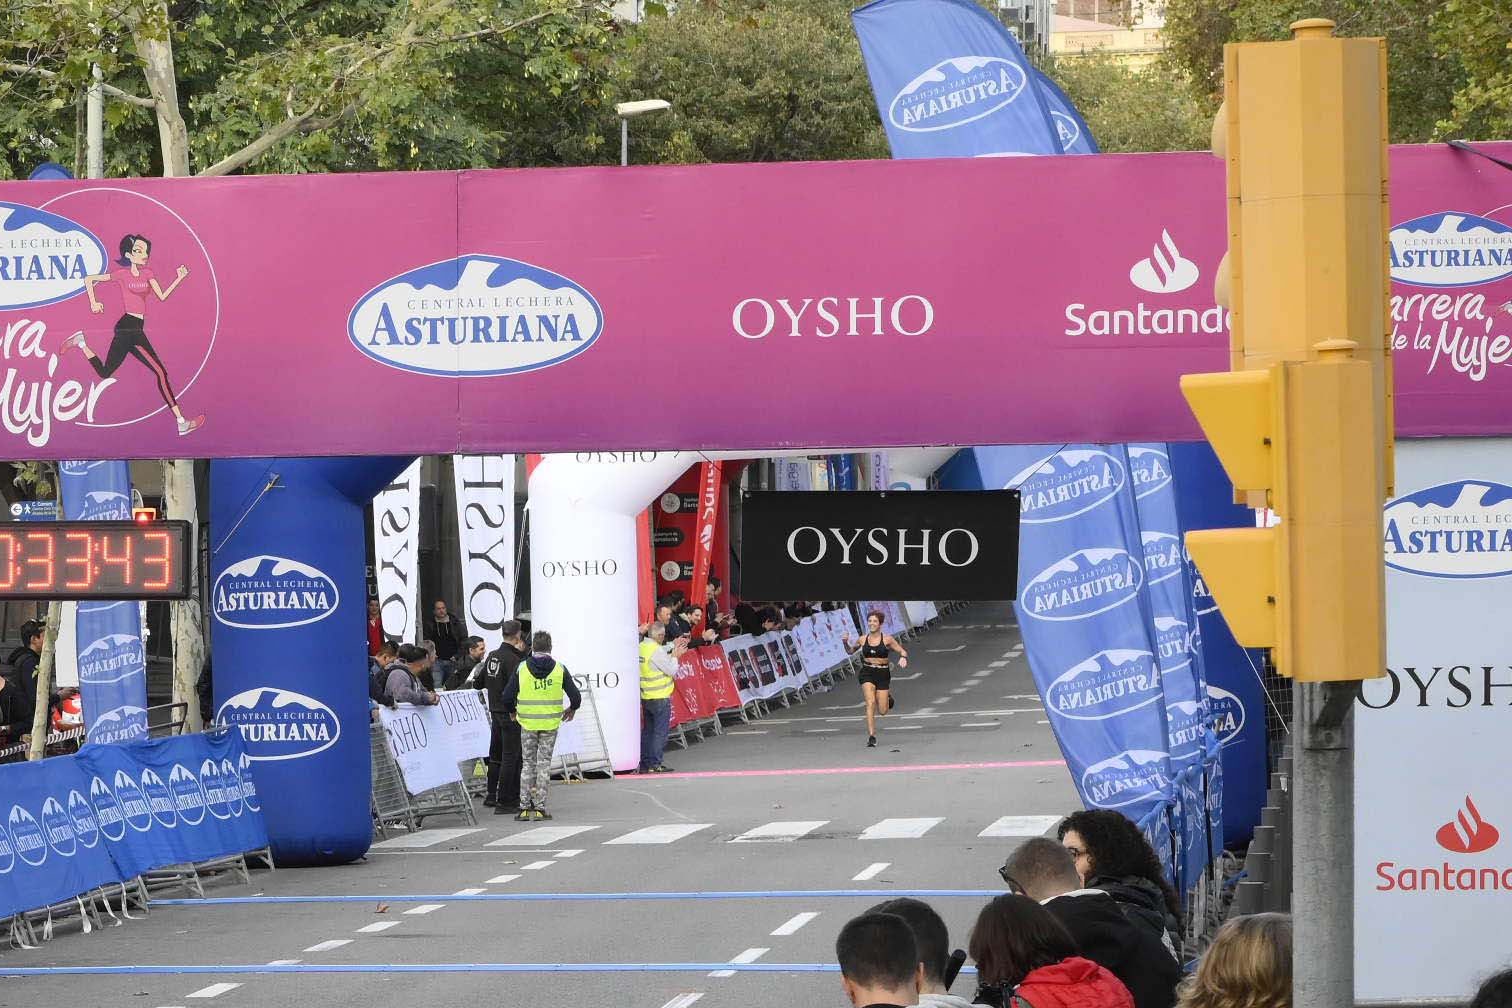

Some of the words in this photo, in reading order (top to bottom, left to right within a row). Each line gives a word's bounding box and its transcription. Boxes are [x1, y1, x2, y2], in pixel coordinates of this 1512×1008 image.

[10, 238, 82, 249] LECHERA
[1404, 238, 1455, 246] CENTRAL
[406, 298, 485, 311] CENTRAL
[493, 295, 575, 308] LECHERA
[1390, 292, 1487, 321] arrera
[367, 302, 583, 346] ASTURIANA
[732, 295, 936, 339] OYSHO
[1065, 303, 1231, 336] Santand
[1413, 322, 1432, 350] la
[1411, 515, 1478, 526] CENTRAL
[787, 526, 979, 567] OYSHO
[542, 558, 618, 578] OYSHO
[229, 581, 271, 590] CENTRAL
[276, 580, 325, 589] LECHERA
[217, 586, 330, 613] ASTURIANA
[574, 671, 620, 689] SHO
[231, 712, 272, 721] CENTRAL
[277, 711, 325, 720] LECHERA
